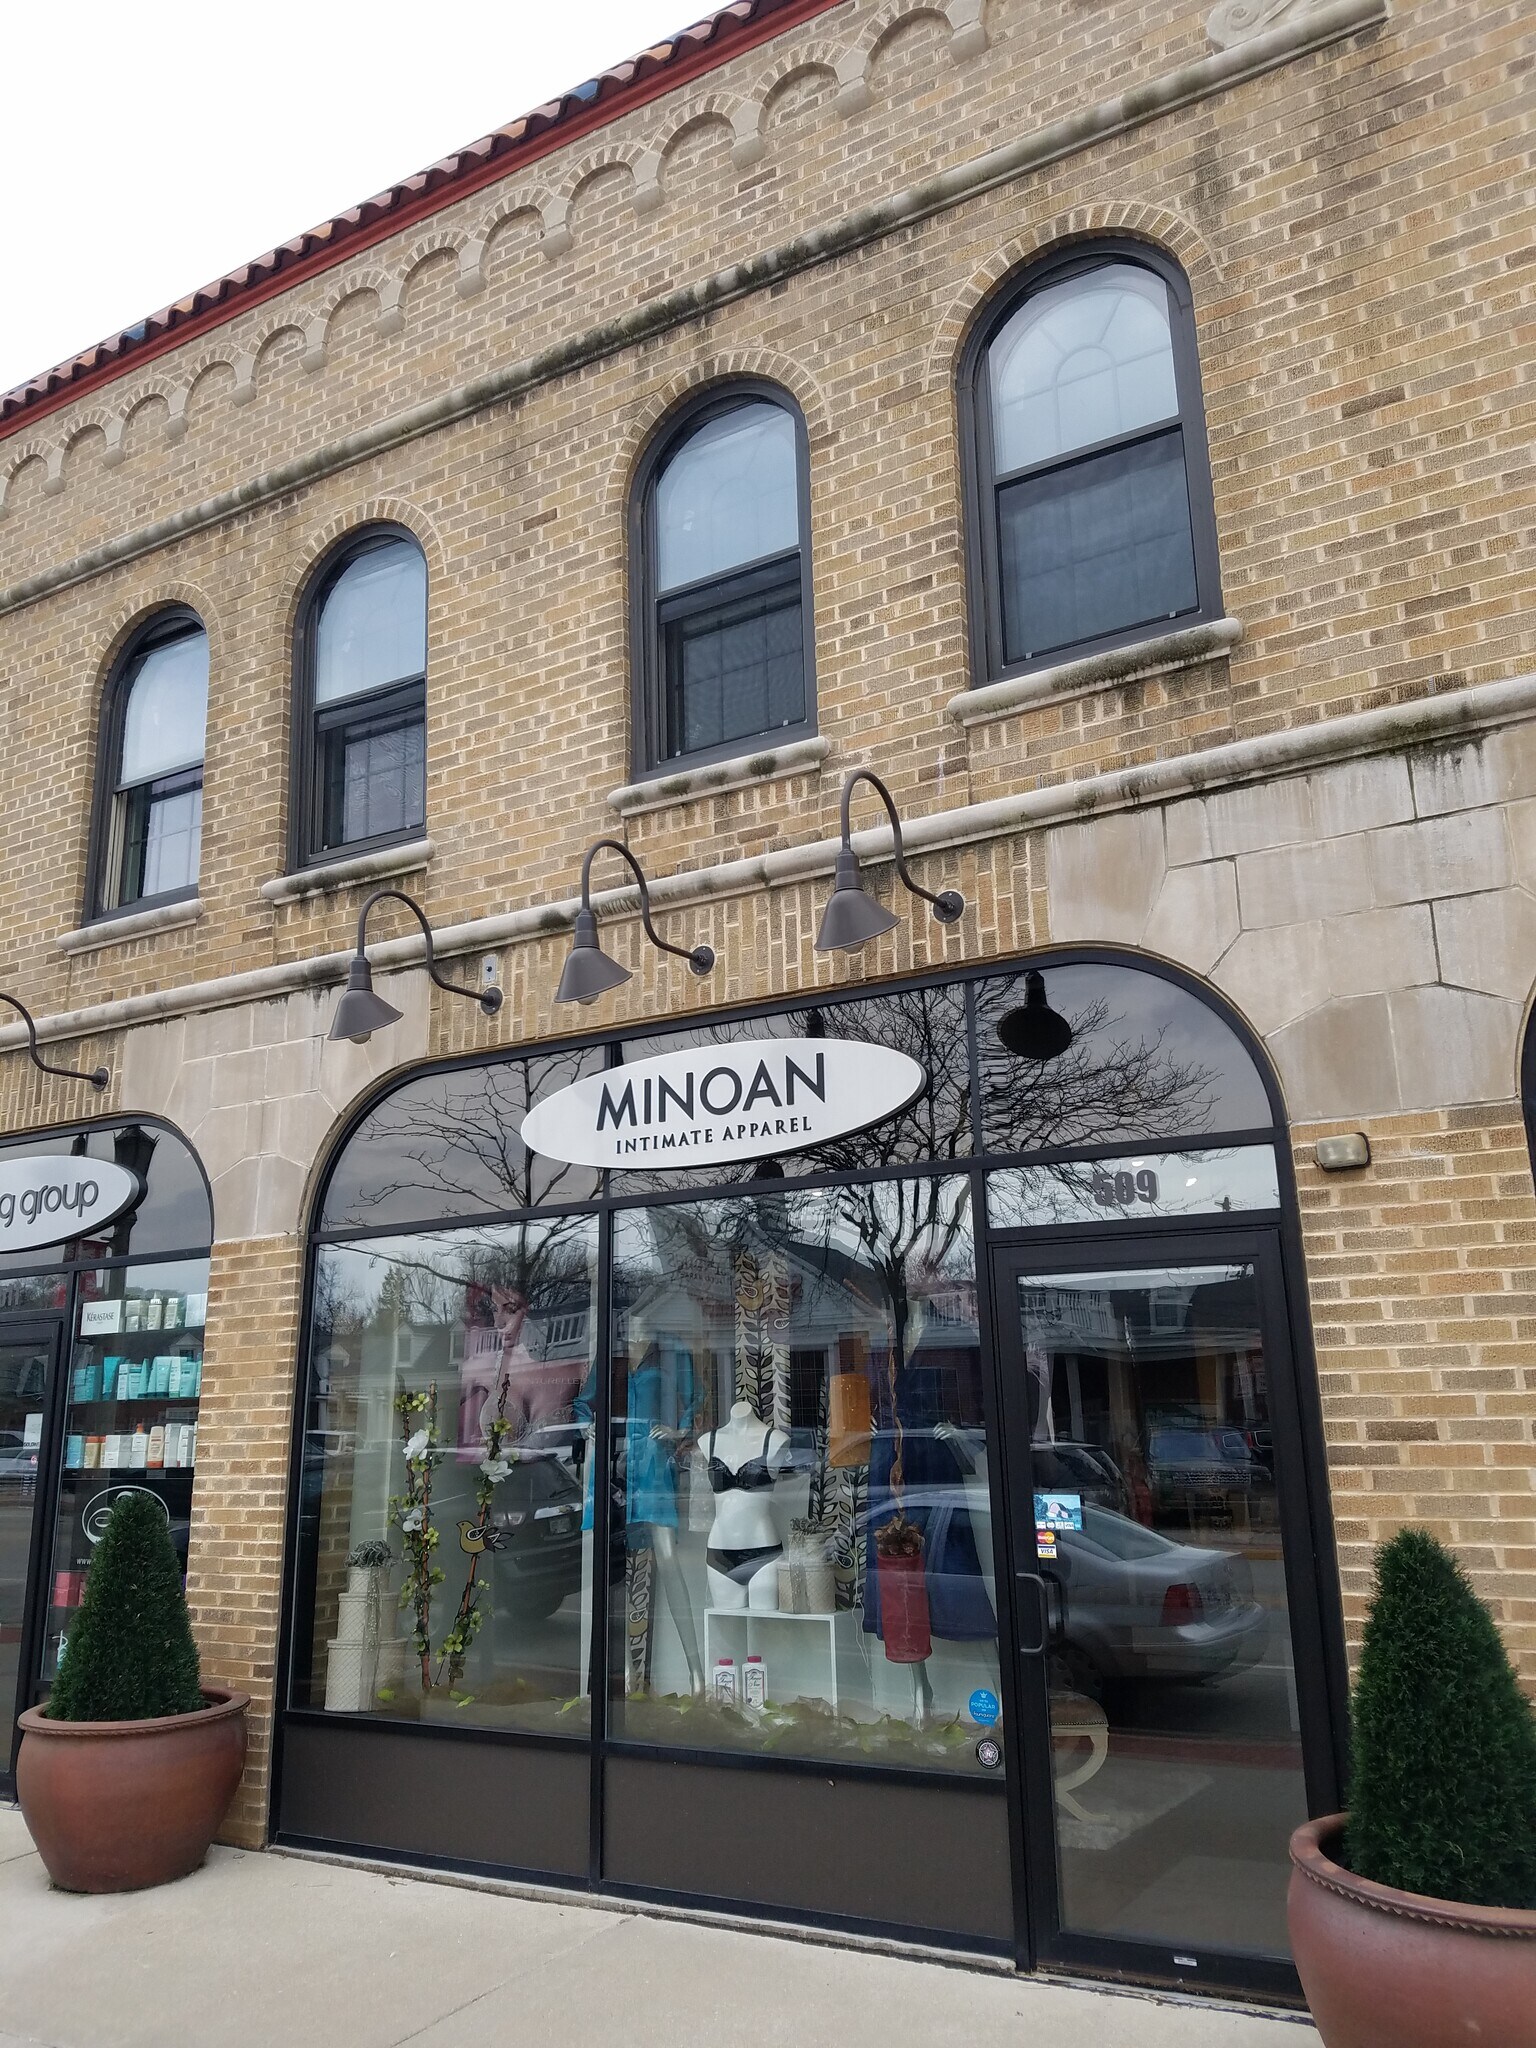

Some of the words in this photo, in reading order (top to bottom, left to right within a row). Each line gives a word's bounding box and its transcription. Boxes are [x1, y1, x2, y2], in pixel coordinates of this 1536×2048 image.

[595, 1052, 827, 1132] MINOAN
[615, 1128, 714, 1155] INTIMATE
[722, 1115, 813, 1141] APPAREL
[20, 1180, 99, 1225] group
[1092, 1169, 1159, 1207] 509
